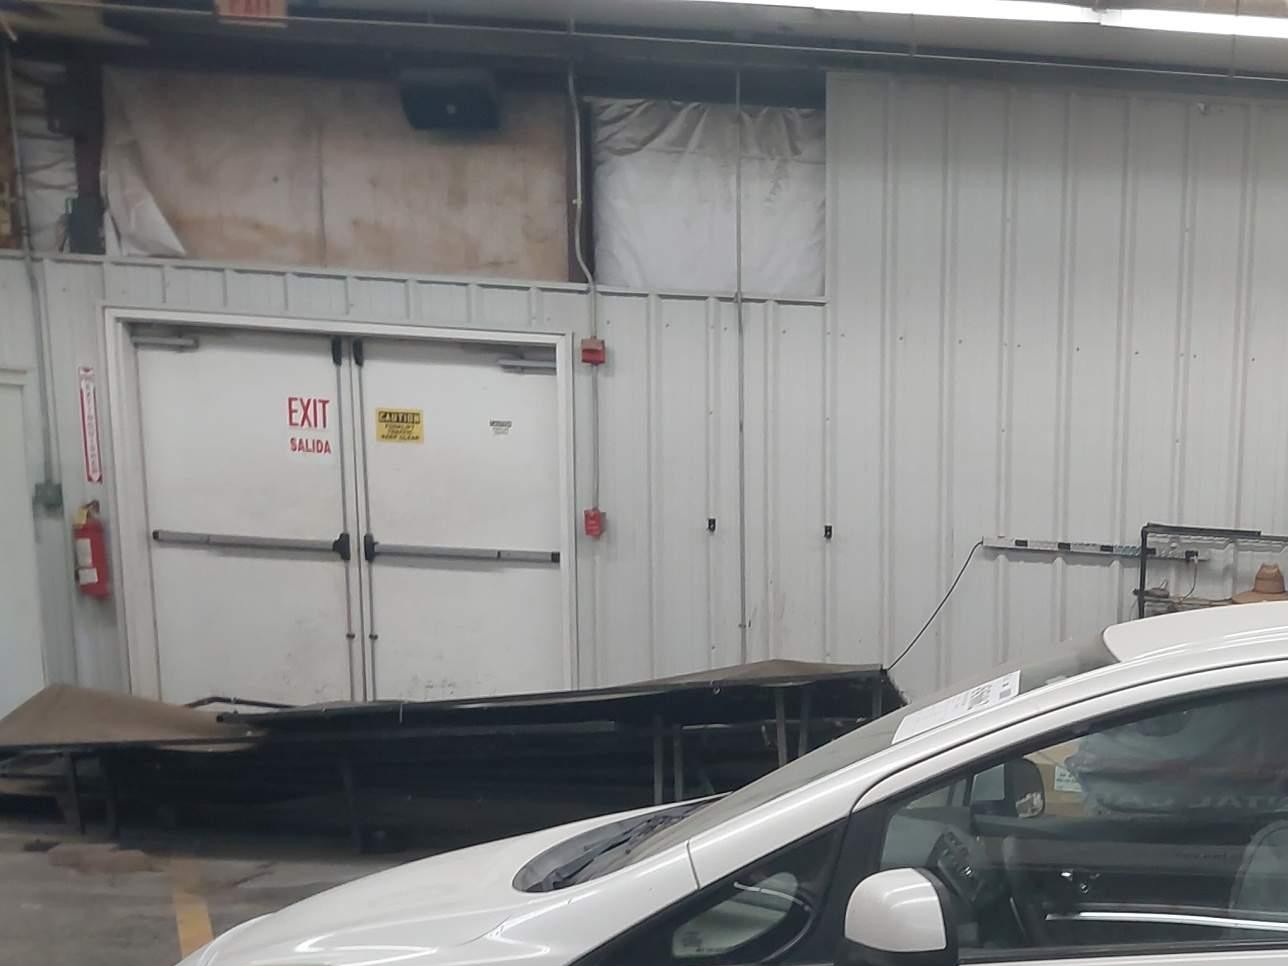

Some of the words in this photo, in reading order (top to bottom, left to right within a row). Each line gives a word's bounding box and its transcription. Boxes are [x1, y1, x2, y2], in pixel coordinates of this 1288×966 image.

[288, 397, 329, 428] EXIT
[379, 412, 420, 423] CAUTION
[289, 438, 332, 454] SALIDA
